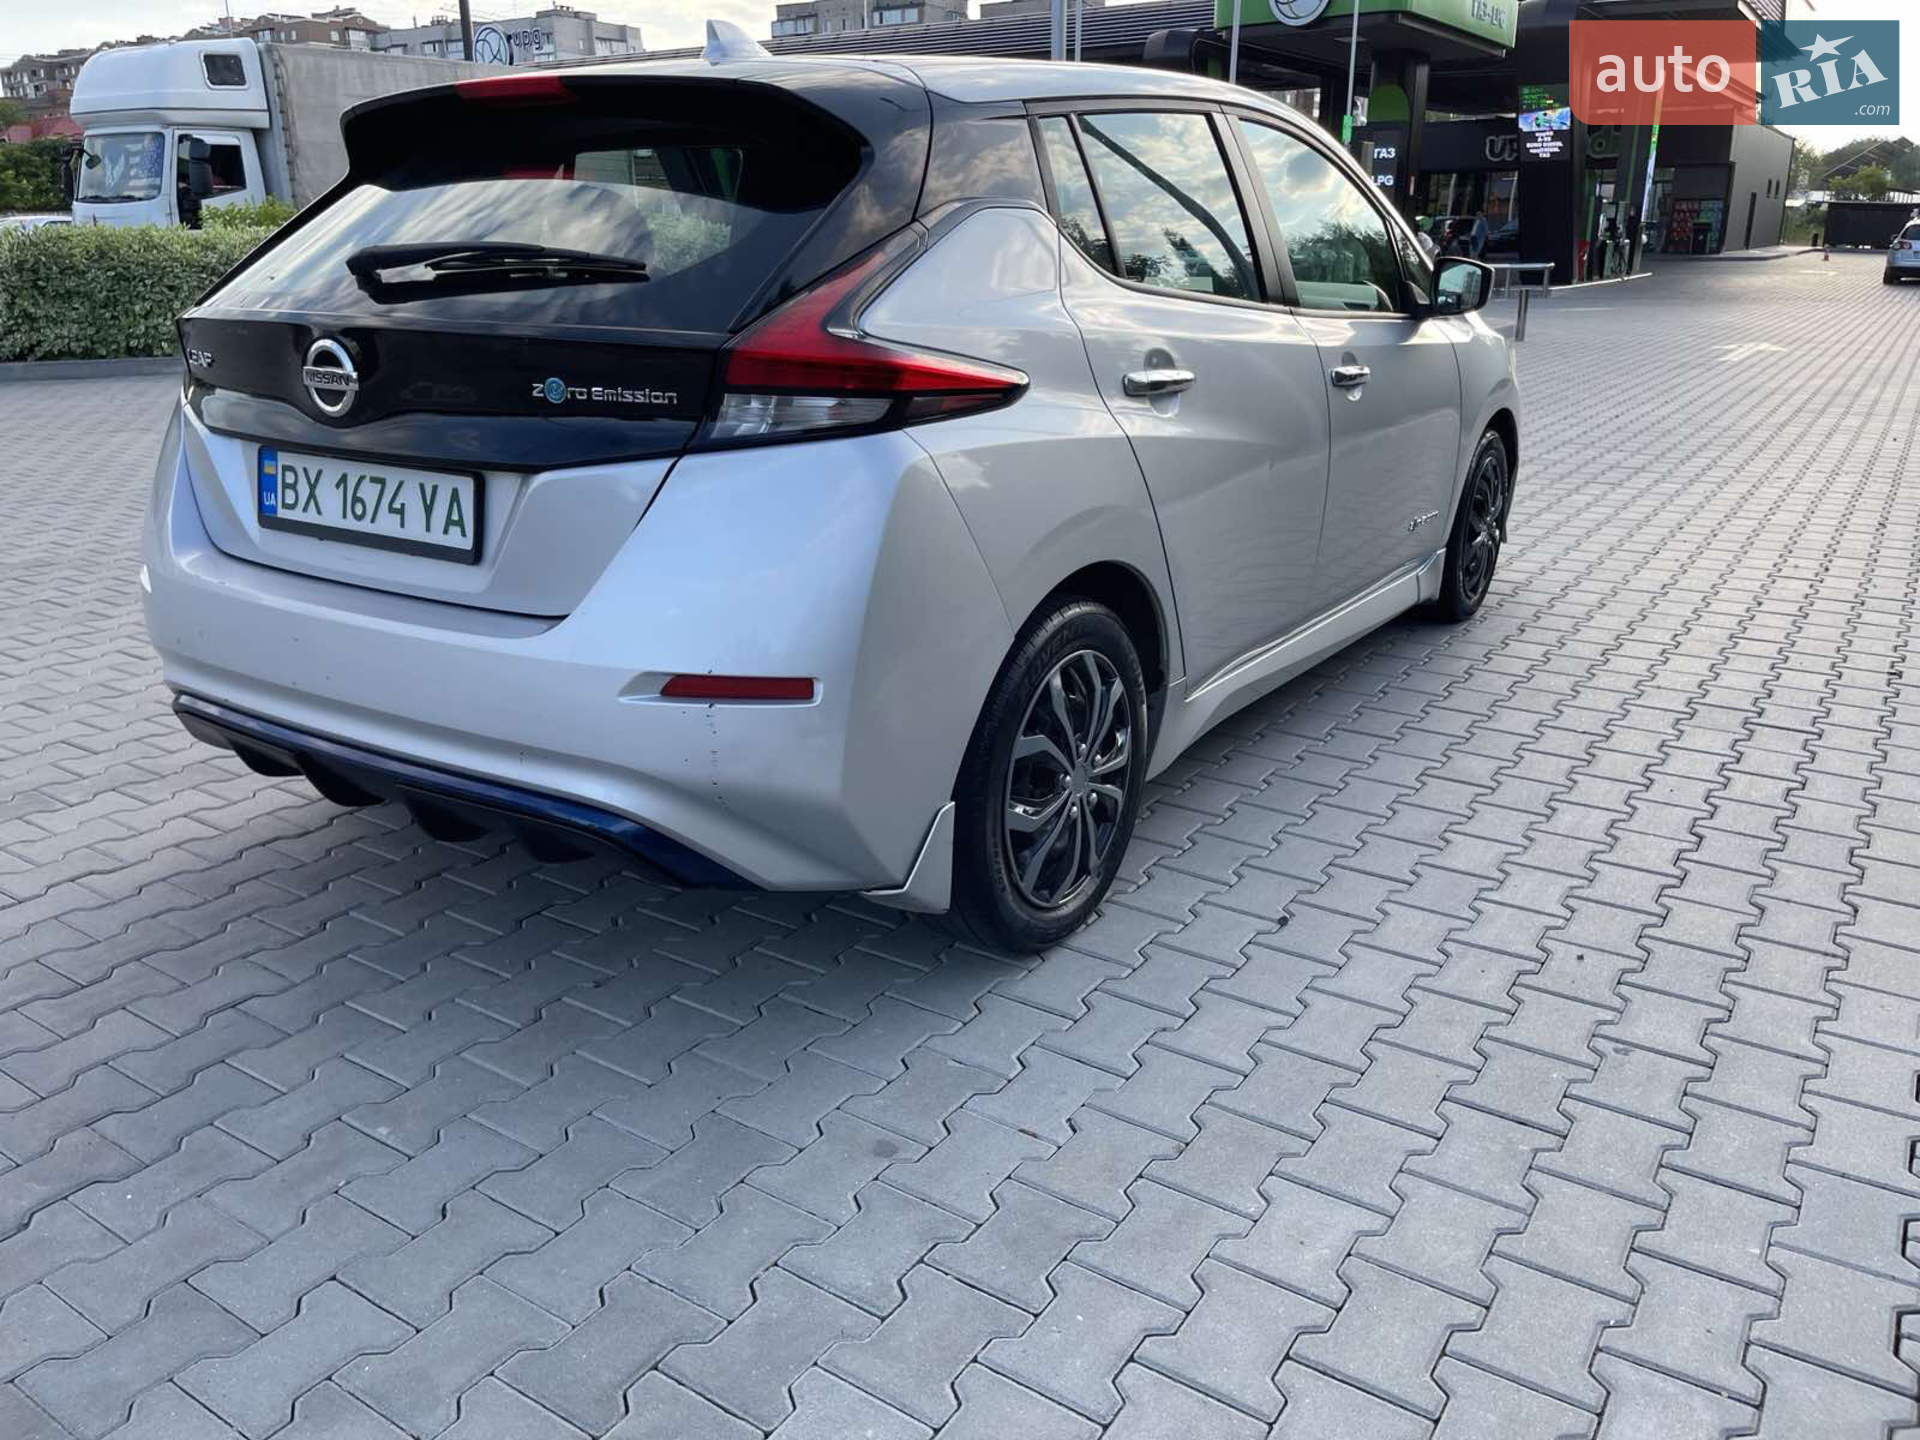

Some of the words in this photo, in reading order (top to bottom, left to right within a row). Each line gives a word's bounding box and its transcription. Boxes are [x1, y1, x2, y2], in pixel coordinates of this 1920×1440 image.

[1373, 147, 1396, 159] ГАЗ
[1371, 174, 1394, 186] LPG
[306, 371, 350, 386] NISSAN
[591, 386, 678, 405] Emission
[263, 491, 277, 506] UA
[280, 464, 324, 516] BX
[334, 471, 406, 529] 1674
[418, 482, 468, 538] YA
